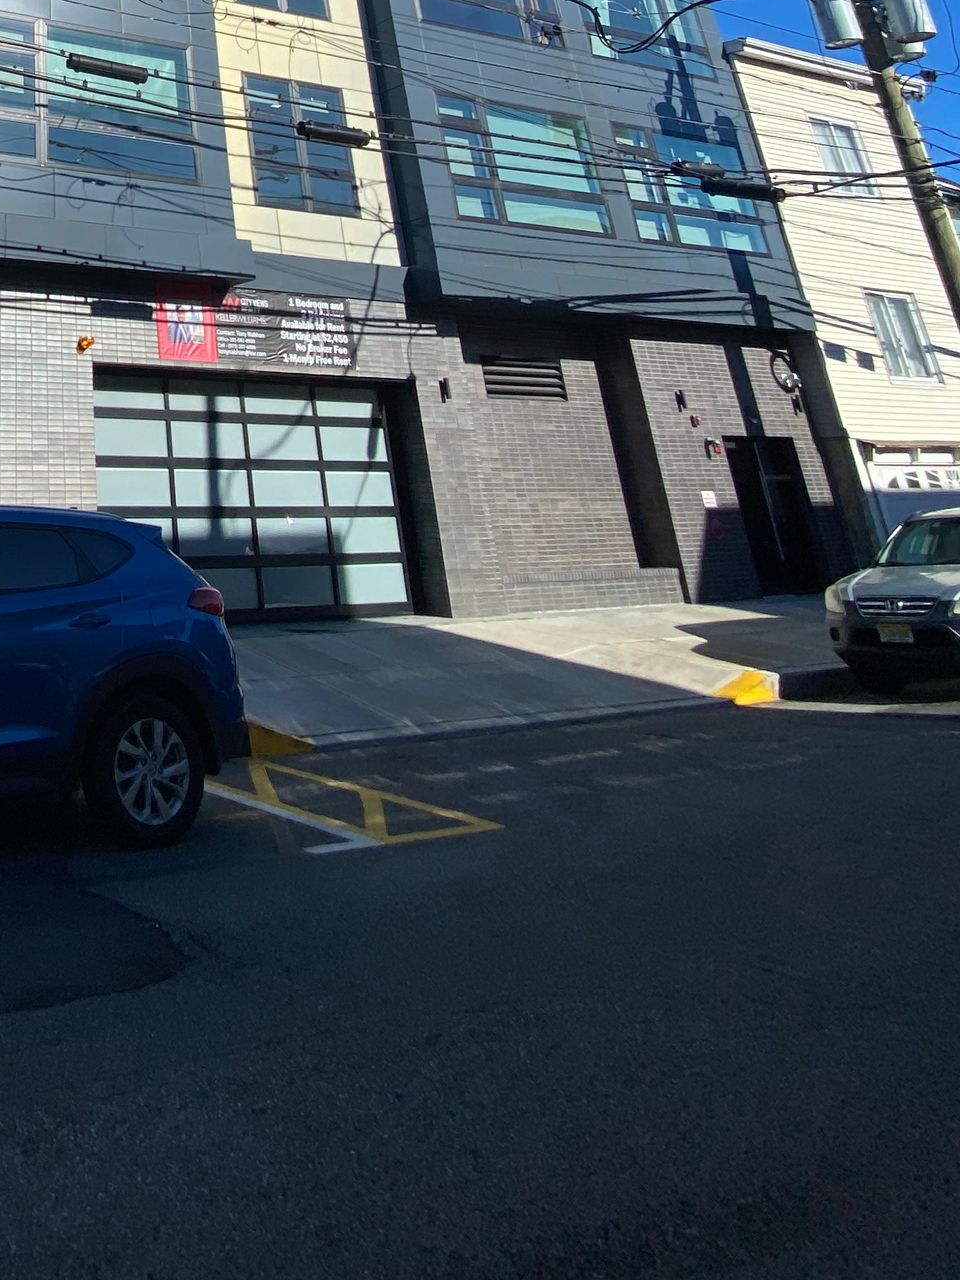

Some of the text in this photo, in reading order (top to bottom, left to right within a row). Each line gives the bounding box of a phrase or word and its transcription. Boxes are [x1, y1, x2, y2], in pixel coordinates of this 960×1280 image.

[288, 298, 344, 311] 1 Bedroom and
[281, 320, 345, 332] Available for Rent
[280, 331, 349, 344] Starting at $2,450
[295, 343, 348, 355] No Broker Fee
[315, 356, 333, 365] Free
[333, 357, 352, 366] Rent
